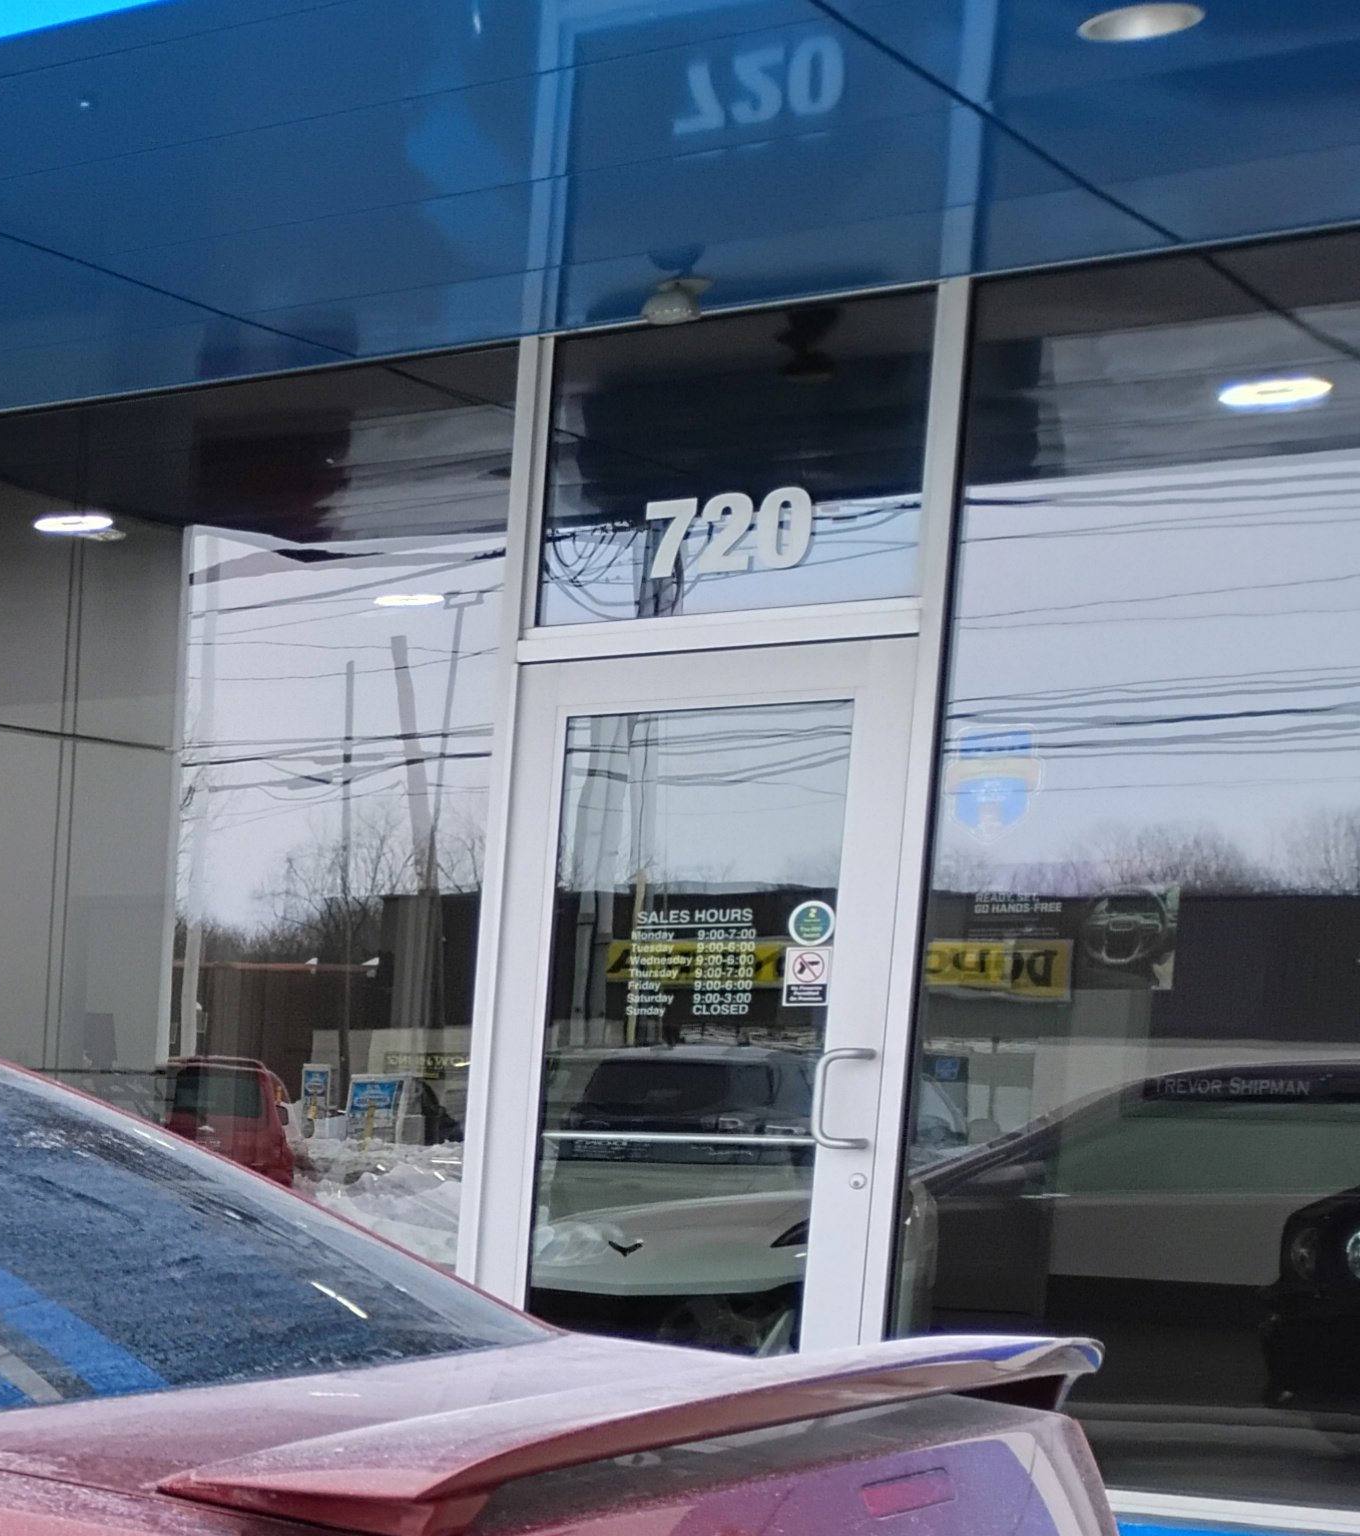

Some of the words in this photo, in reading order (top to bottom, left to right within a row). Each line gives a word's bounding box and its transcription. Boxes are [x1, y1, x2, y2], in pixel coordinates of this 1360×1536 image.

[646, 486, 813, 579] 720
[991, 902, 1062, 913] HANDS-FREE
[636, 909, 690, 924] SALES
[694, 908, 754, 923] HOURS
[631, 930, 675, 941] Monday
[631, 943, 675, 954] Tuesday
[629, 955, 693, 966] Wednesday
[630, 968, 678, 979] Thursday
[628, 981, 661, 991] Friday
[627, 993, 674, 1004] Saturday
[625, 1006, 666, 1016] Sunday
[693, 1004, 749, 1015] CLOSED
[1229, 1077, 1311, 1096] SHIPMAN
